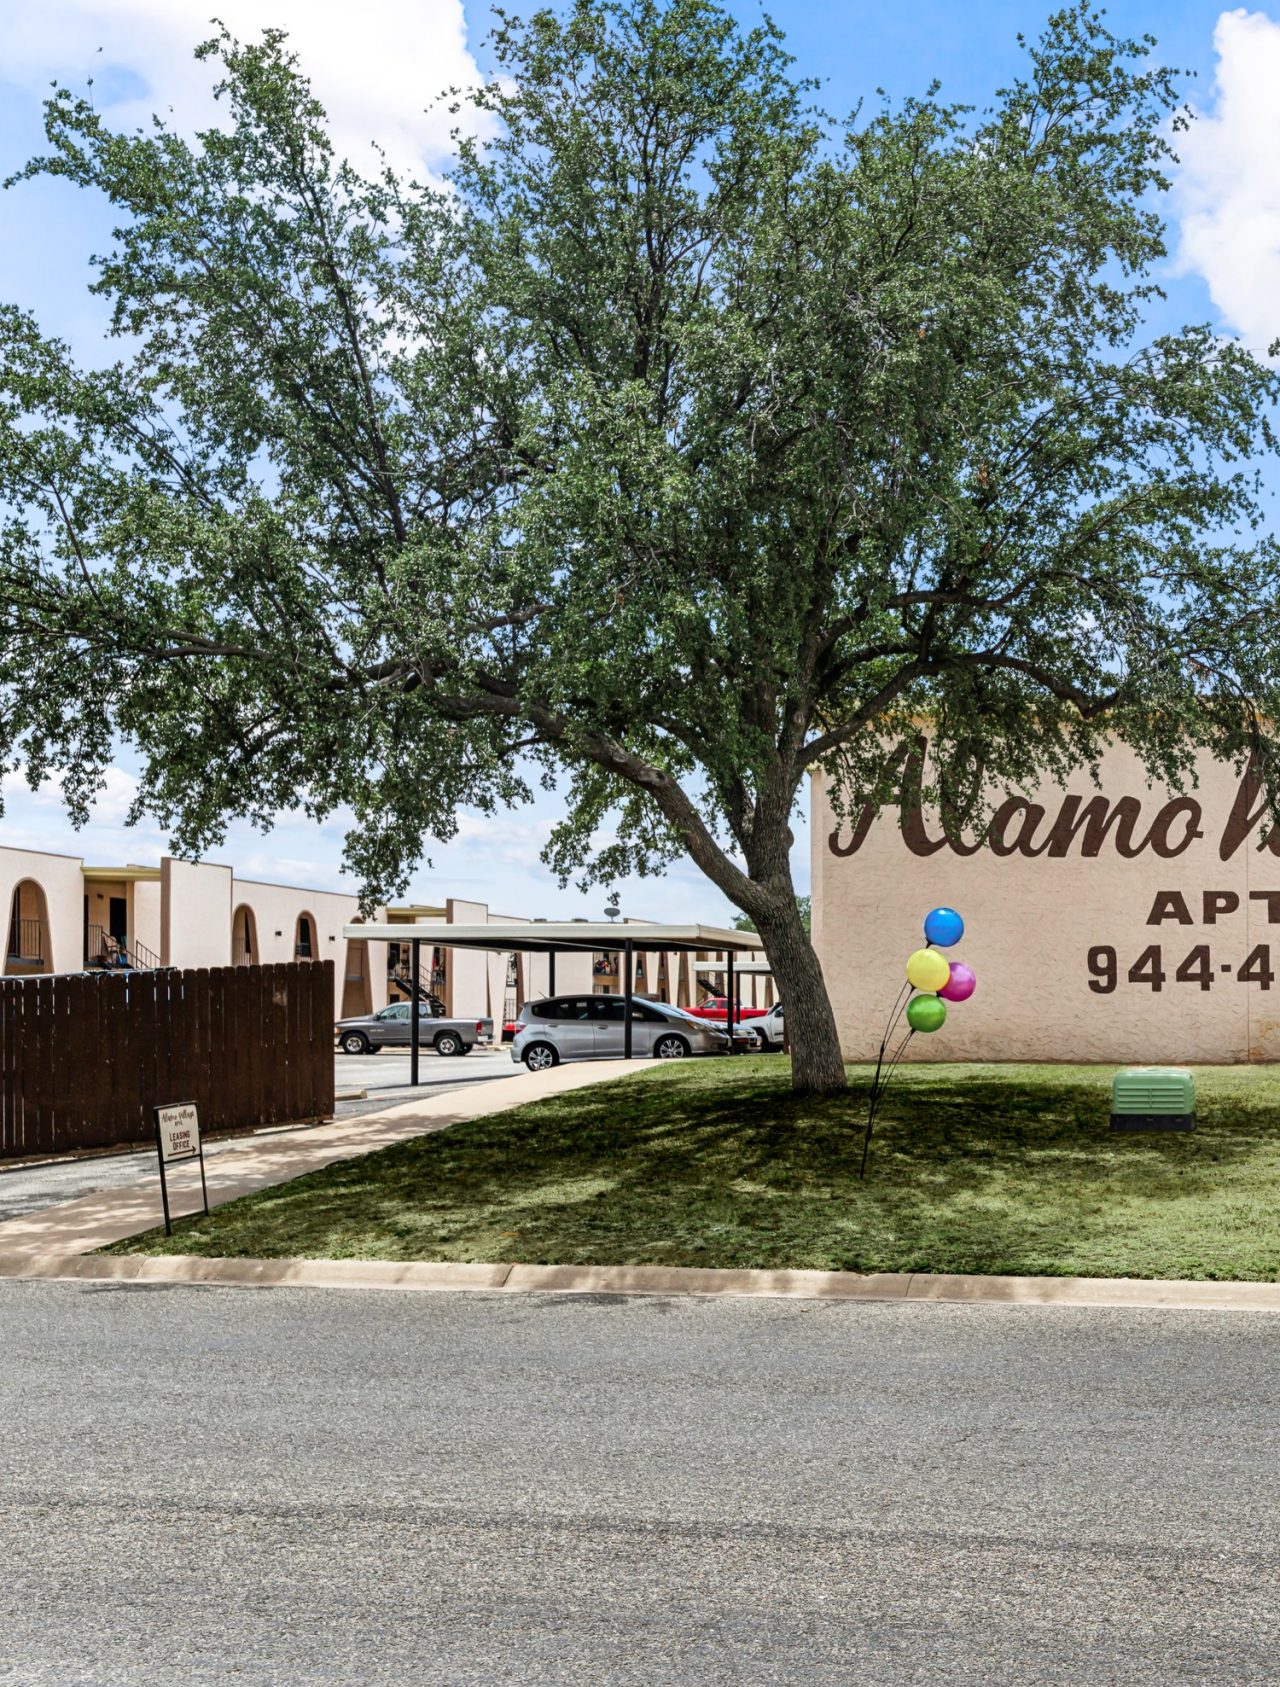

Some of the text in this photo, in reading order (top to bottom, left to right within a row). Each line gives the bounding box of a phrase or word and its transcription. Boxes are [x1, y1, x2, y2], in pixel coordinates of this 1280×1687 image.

[828, 735, 1204, 858] Alamo
[169, 1130, 190, 1141] LEASING
[173, 1140, 190, 1150] OFFICE
